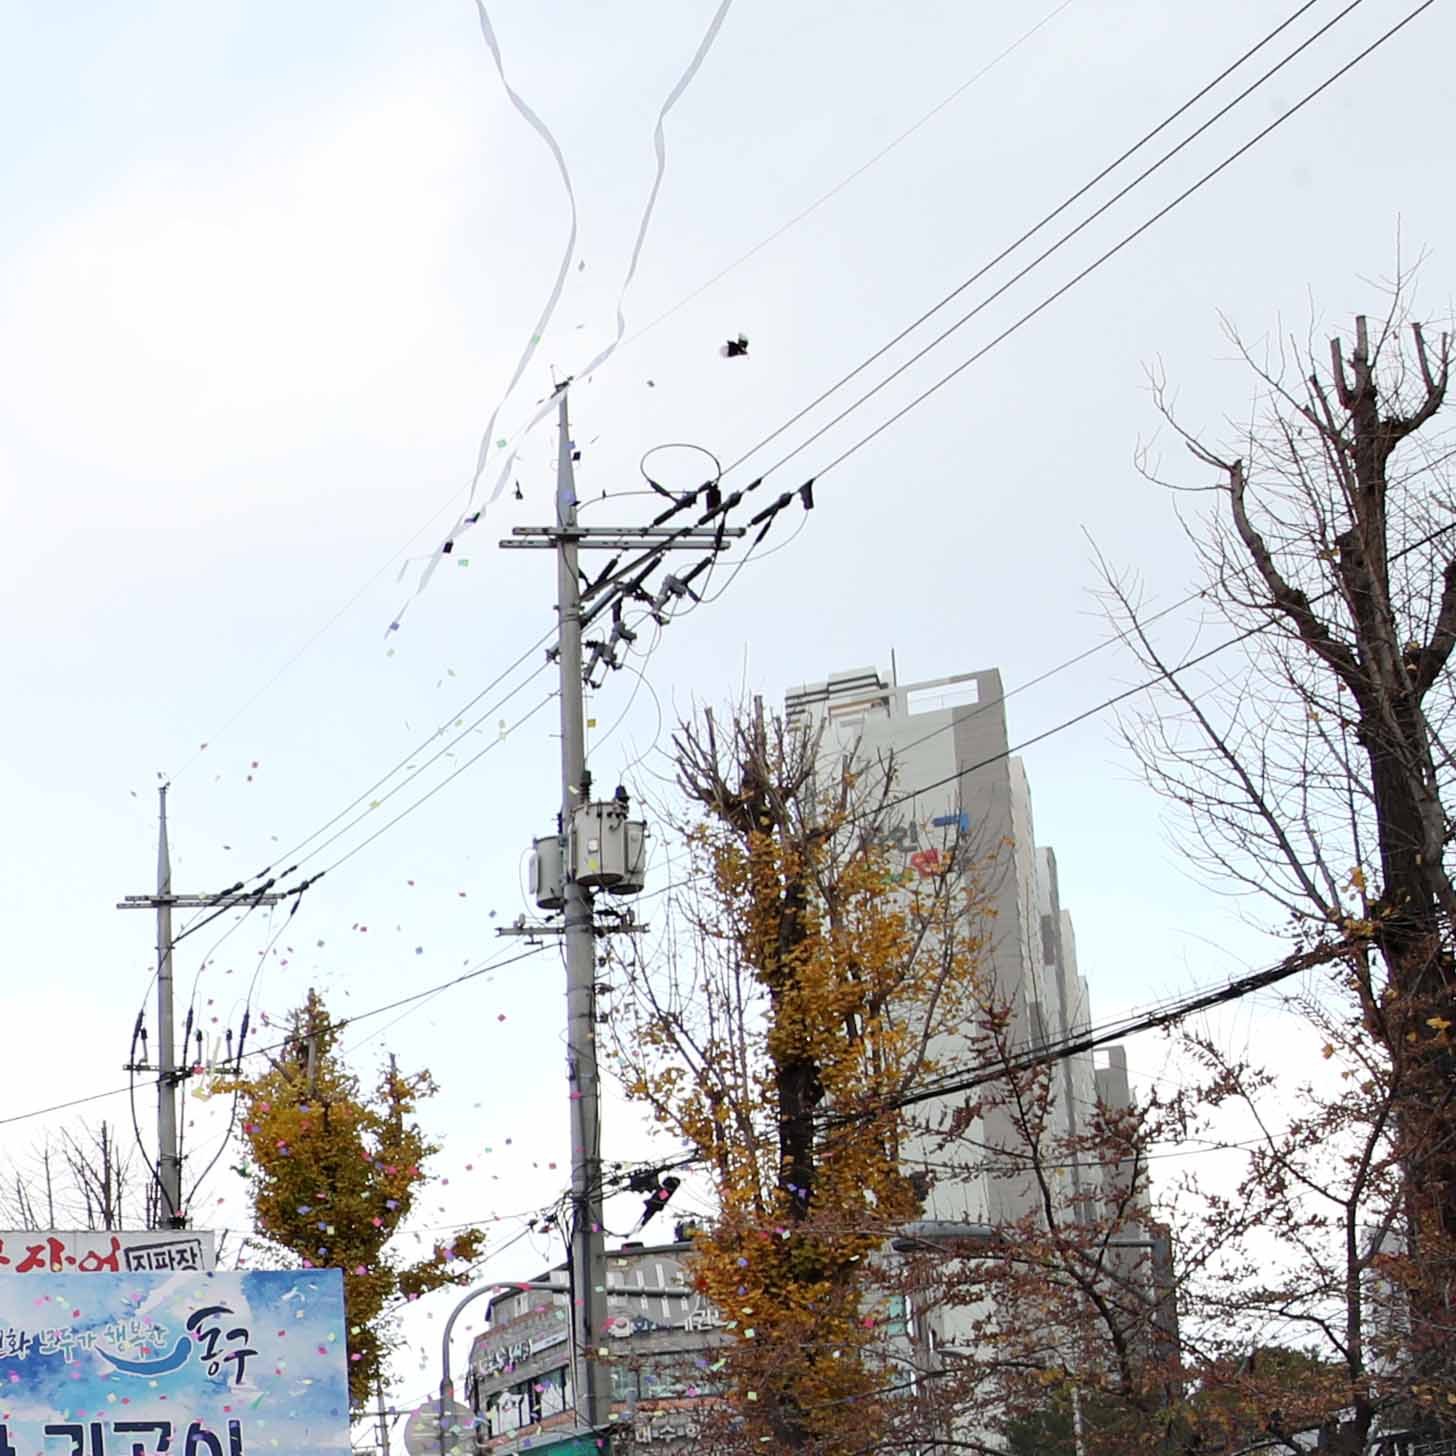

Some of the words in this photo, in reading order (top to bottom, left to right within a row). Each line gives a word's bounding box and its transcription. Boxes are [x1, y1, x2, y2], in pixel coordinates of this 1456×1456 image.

[39, 1329, 96, 1362] 모두가
[102, 1321, 167, 1360] 행복한
[186, 1305, 258, 1385] 동구
